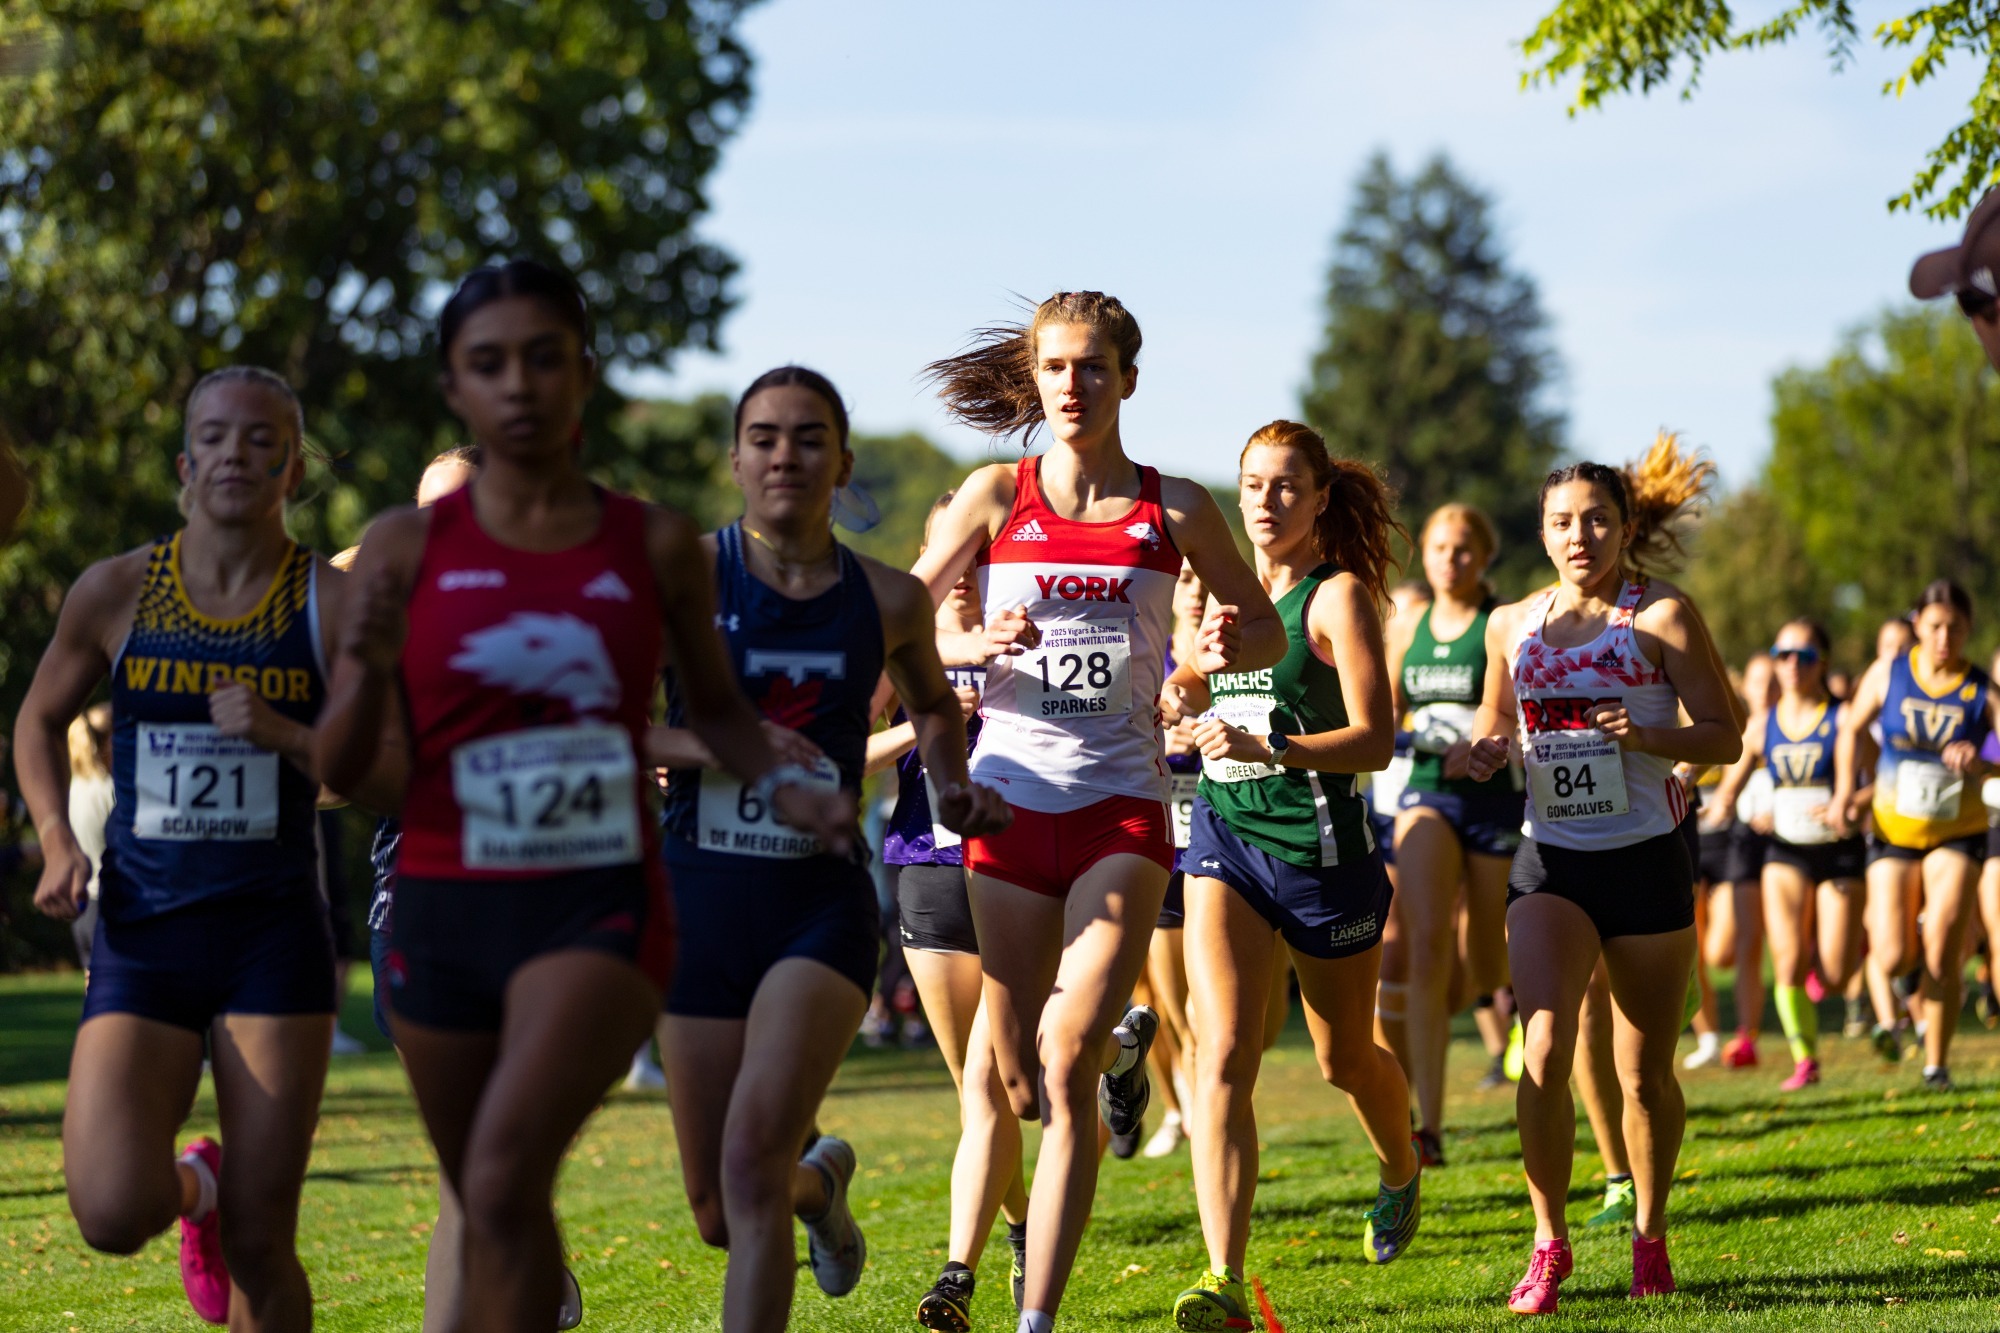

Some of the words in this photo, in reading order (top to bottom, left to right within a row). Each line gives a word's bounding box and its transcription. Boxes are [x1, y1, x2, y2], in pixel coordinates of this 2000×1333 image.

[1012, 533, 1048, 542] adidas
[1034, 575, 1133, 604] YORK
[1045, 638, 1077, 648] WESTERN
[1079, 635, 1126, 646] INVITATIONAL
[1051, 628, 1066, 636] 2025
[1067, 627, 1089, 637] Vigars
[1090, 626, 1097, 634] &
[1098, 625, 1118, 634] Salter
[1036, 652, 1112, 693] 128
[1210, 668, 1273, 694] LAKERS
[1042, 697, 1107, 716] SPARKES
[1520, 696, 1623, 734] RED
[1551, 751, 1577, 761] WESTERN
[1578, 747, 1617, 758] INVITATIONAL
[1226, 764, 1257, 779] GREEN
[1553, 763, 1596, 798] 84
[164, 763, 246, 809] 121
[498, 772, 606, 829] 124
[1547, 800, 1613, 819] GONCALVES
[161, 816, 250, 837] SCARROW
[709, 829, 728, 847] DE
[1331, 918, 1377, 942] LAKERS
